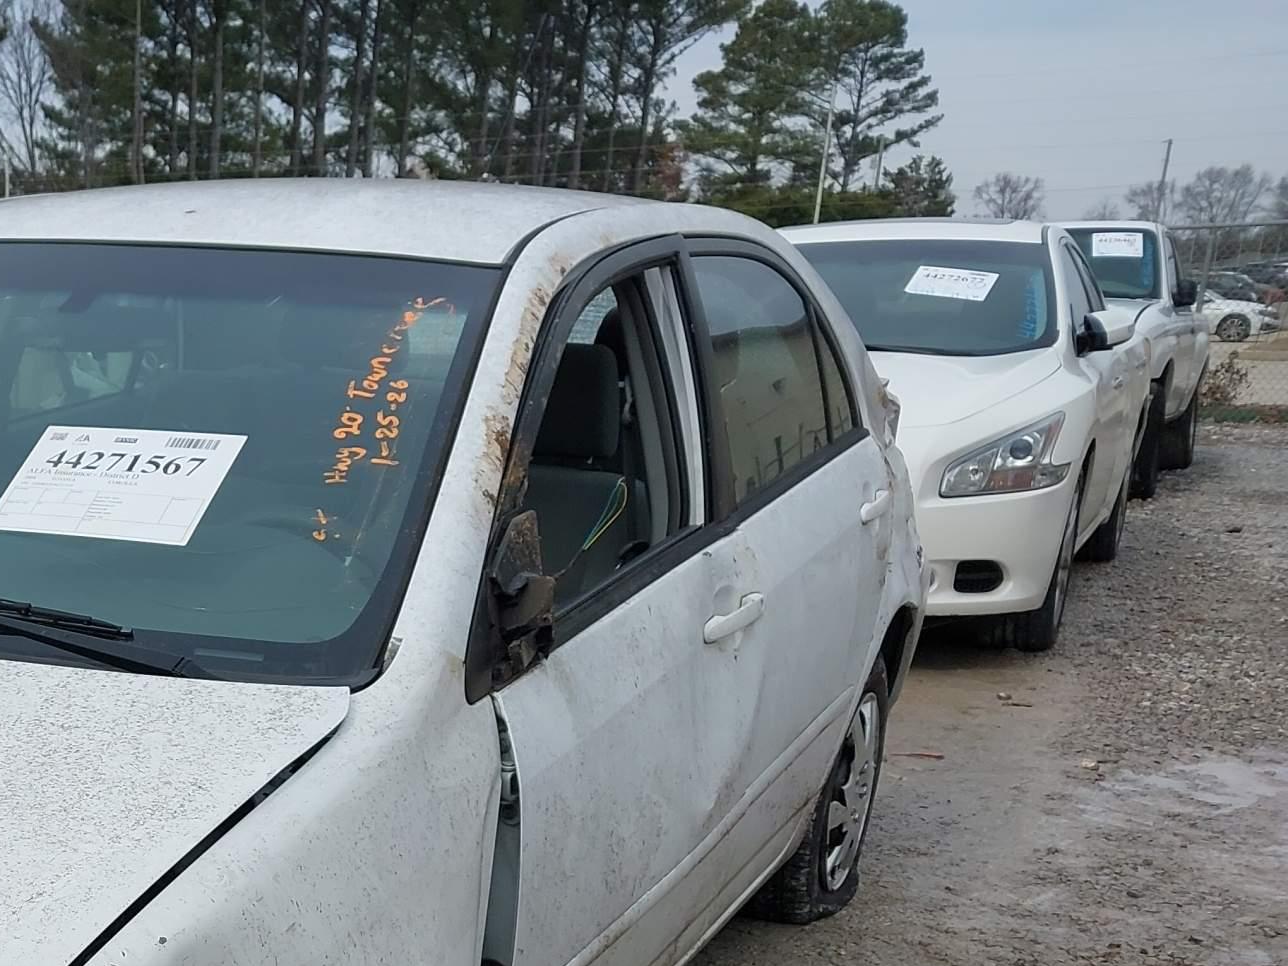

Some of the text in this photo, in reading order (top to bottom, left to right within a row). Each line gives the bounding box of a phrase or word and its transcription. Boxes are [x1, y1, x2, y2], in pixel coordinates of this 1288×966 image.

[333, 411, 364, 439] 20
[45, 449, 208, 477] 44271567
[54, 468, 92, 477] Insurance
